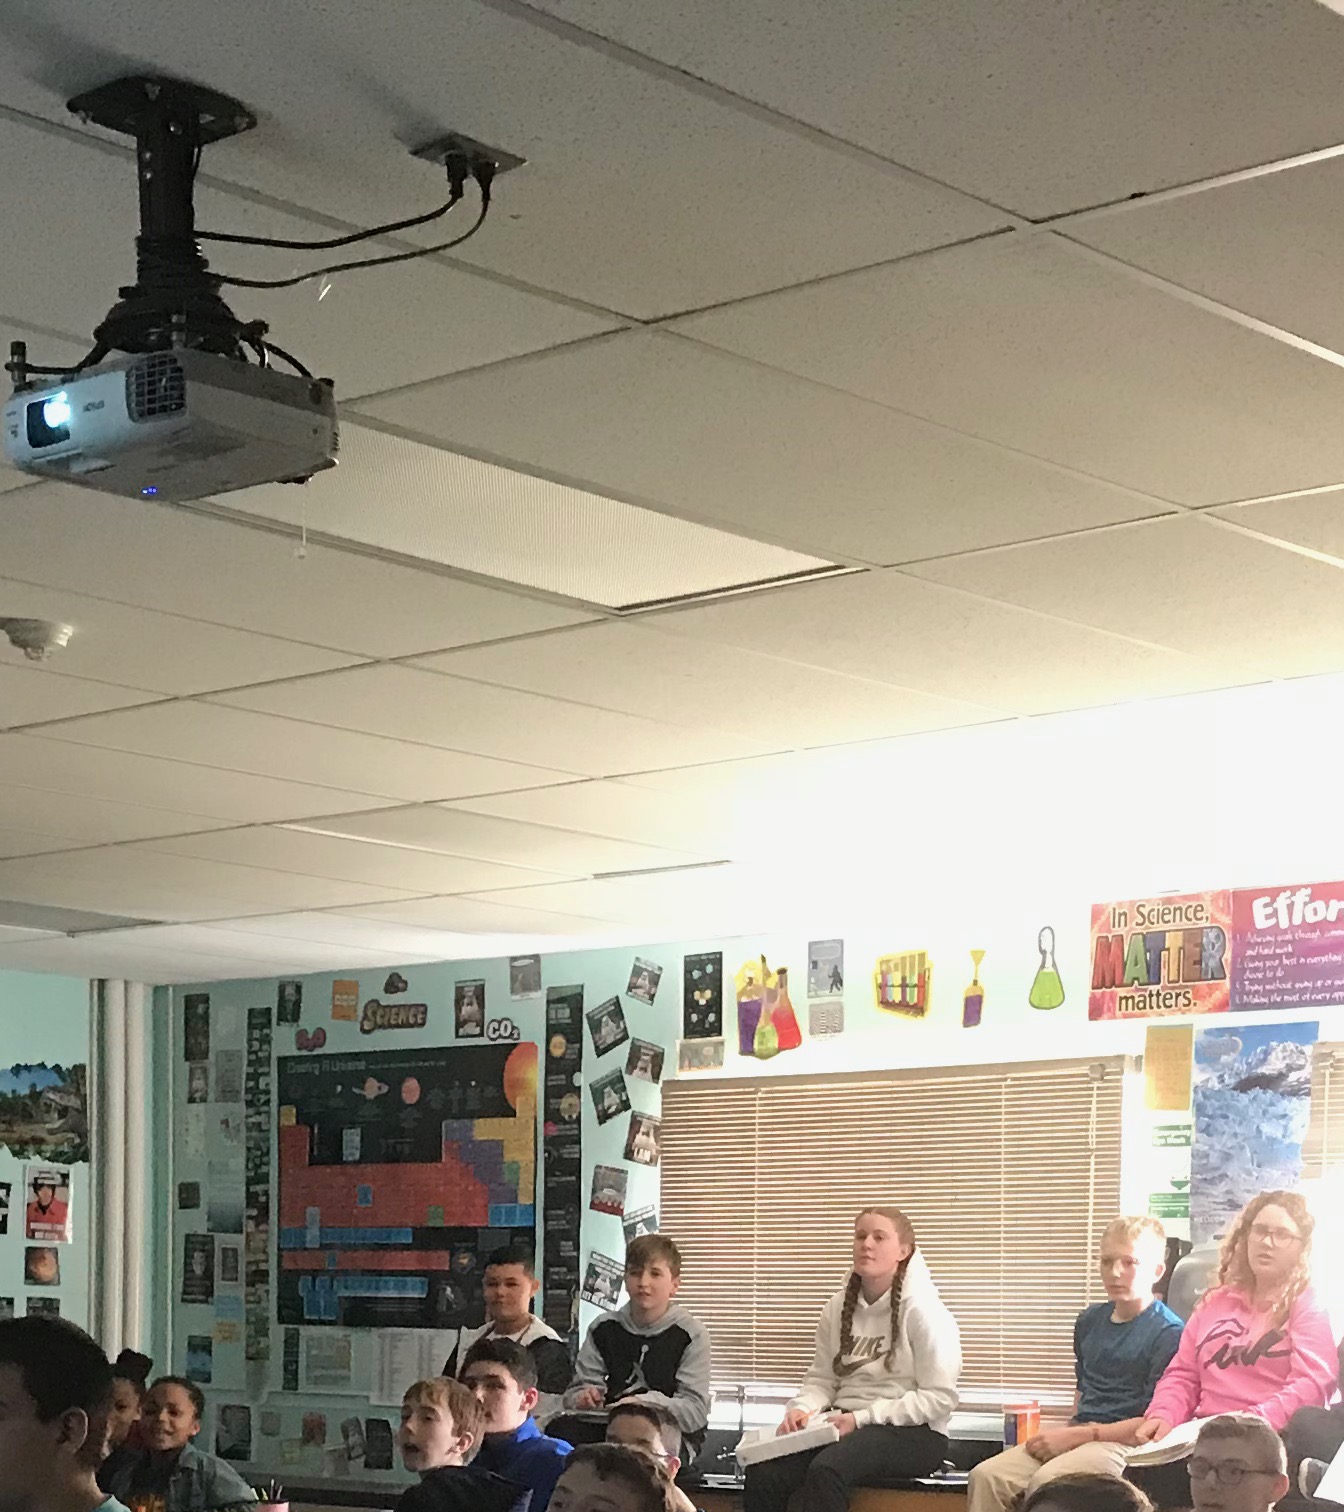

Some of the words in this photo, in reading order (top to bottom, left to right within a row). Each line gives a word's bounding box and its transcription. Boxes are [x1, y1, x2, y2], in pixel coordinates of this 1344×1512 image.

[1111, 907, 1128, 929] In
[1135, 903, 1209, 927] Science,
[1091, 925, 1227, 990] MATTER
[1118, 988, 1198, 1012] matters.
[360, 999, 427, 1034] SCIENCE
